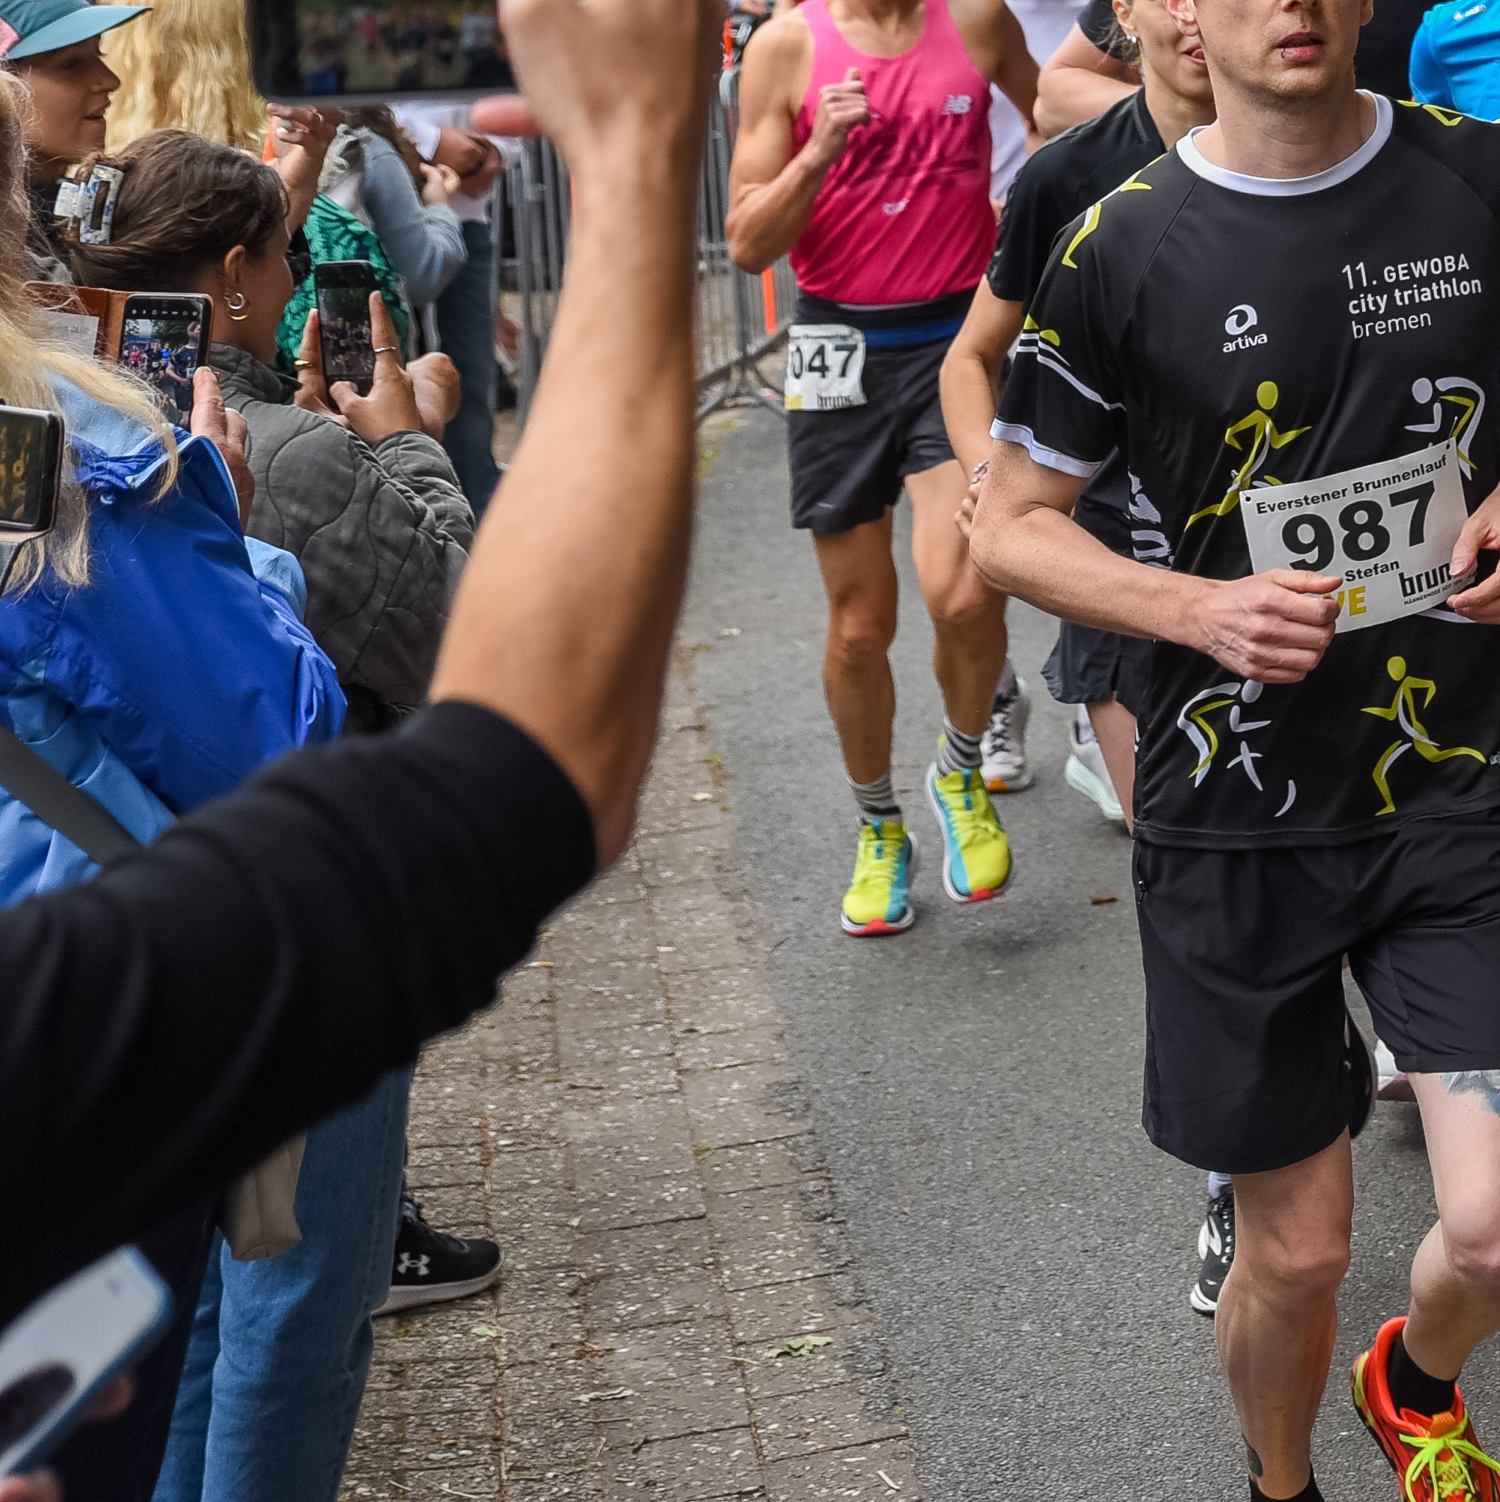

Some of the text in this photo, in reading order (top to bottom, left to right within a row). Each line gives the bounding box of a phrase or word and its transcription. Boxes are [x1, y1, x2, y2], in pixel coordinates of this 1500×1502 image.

[1341, 253, 1470, 291] 11. GEWOBA
[1348, 277, 1483, 315] city triathlon
[1222, 333, 1269, 353] artiva
[1351, 312, 1433, 340] bremen
[1256, 454, 1448, 515] Everstener Brunnenlauf
[1281, 480, 1436, 574] 987
[1344, 560, 1401, 583] Stefan
[1398, 562, 1452, 598] brun
